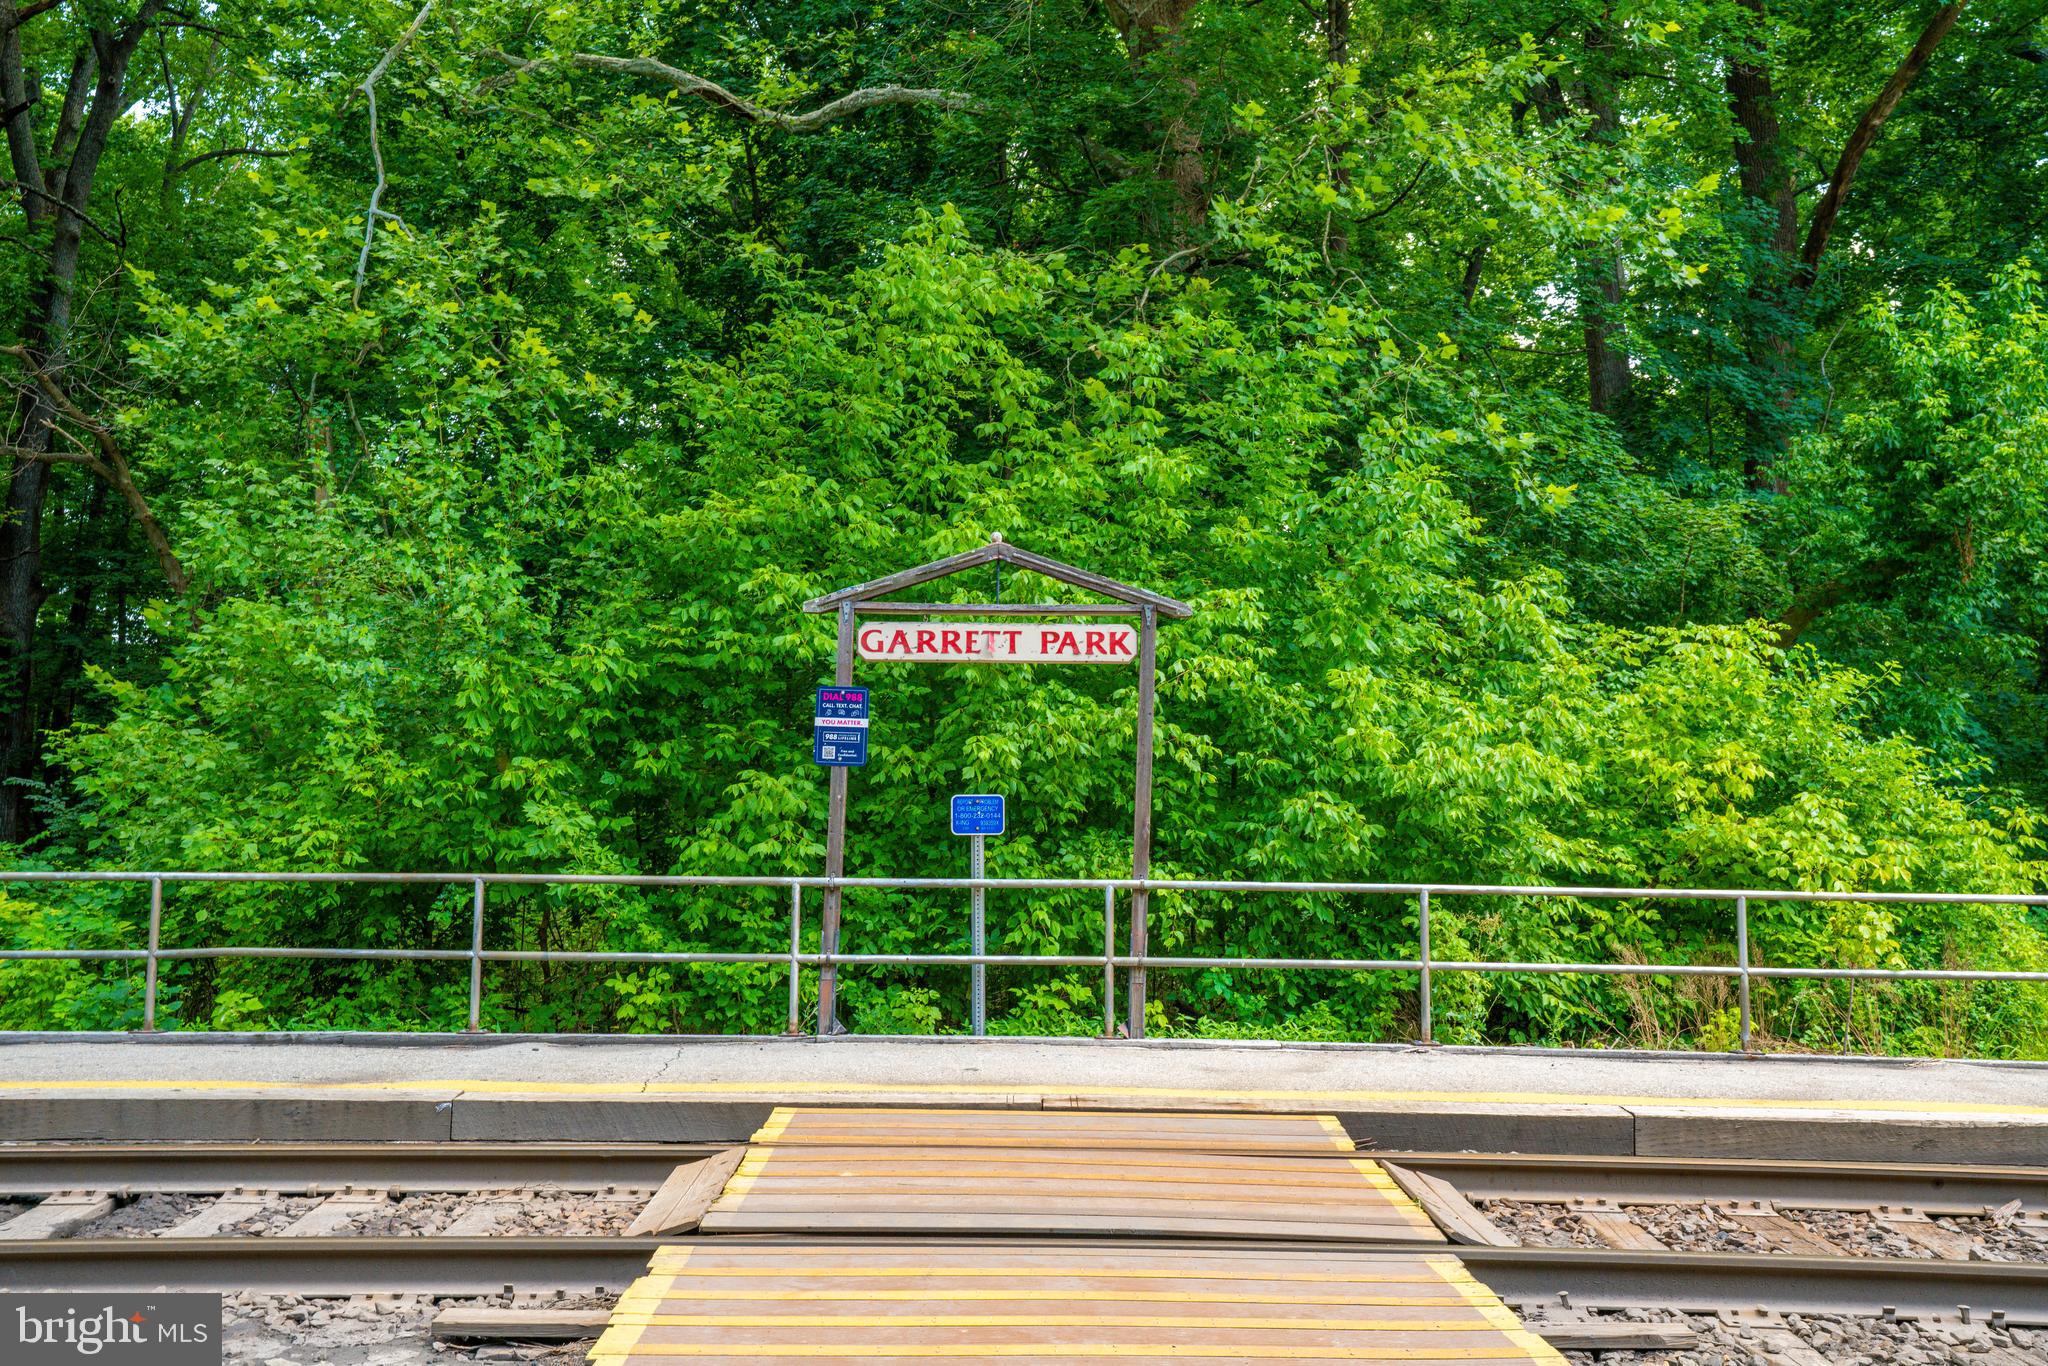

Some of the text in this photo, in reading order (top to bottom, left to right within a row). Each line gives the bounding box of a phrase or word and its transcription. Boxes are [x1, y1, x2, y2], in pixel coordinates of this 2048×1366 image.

[860, 629, 1133, 655] GARRETT PARK
[823, 692, 863, 702] DIAL 988
